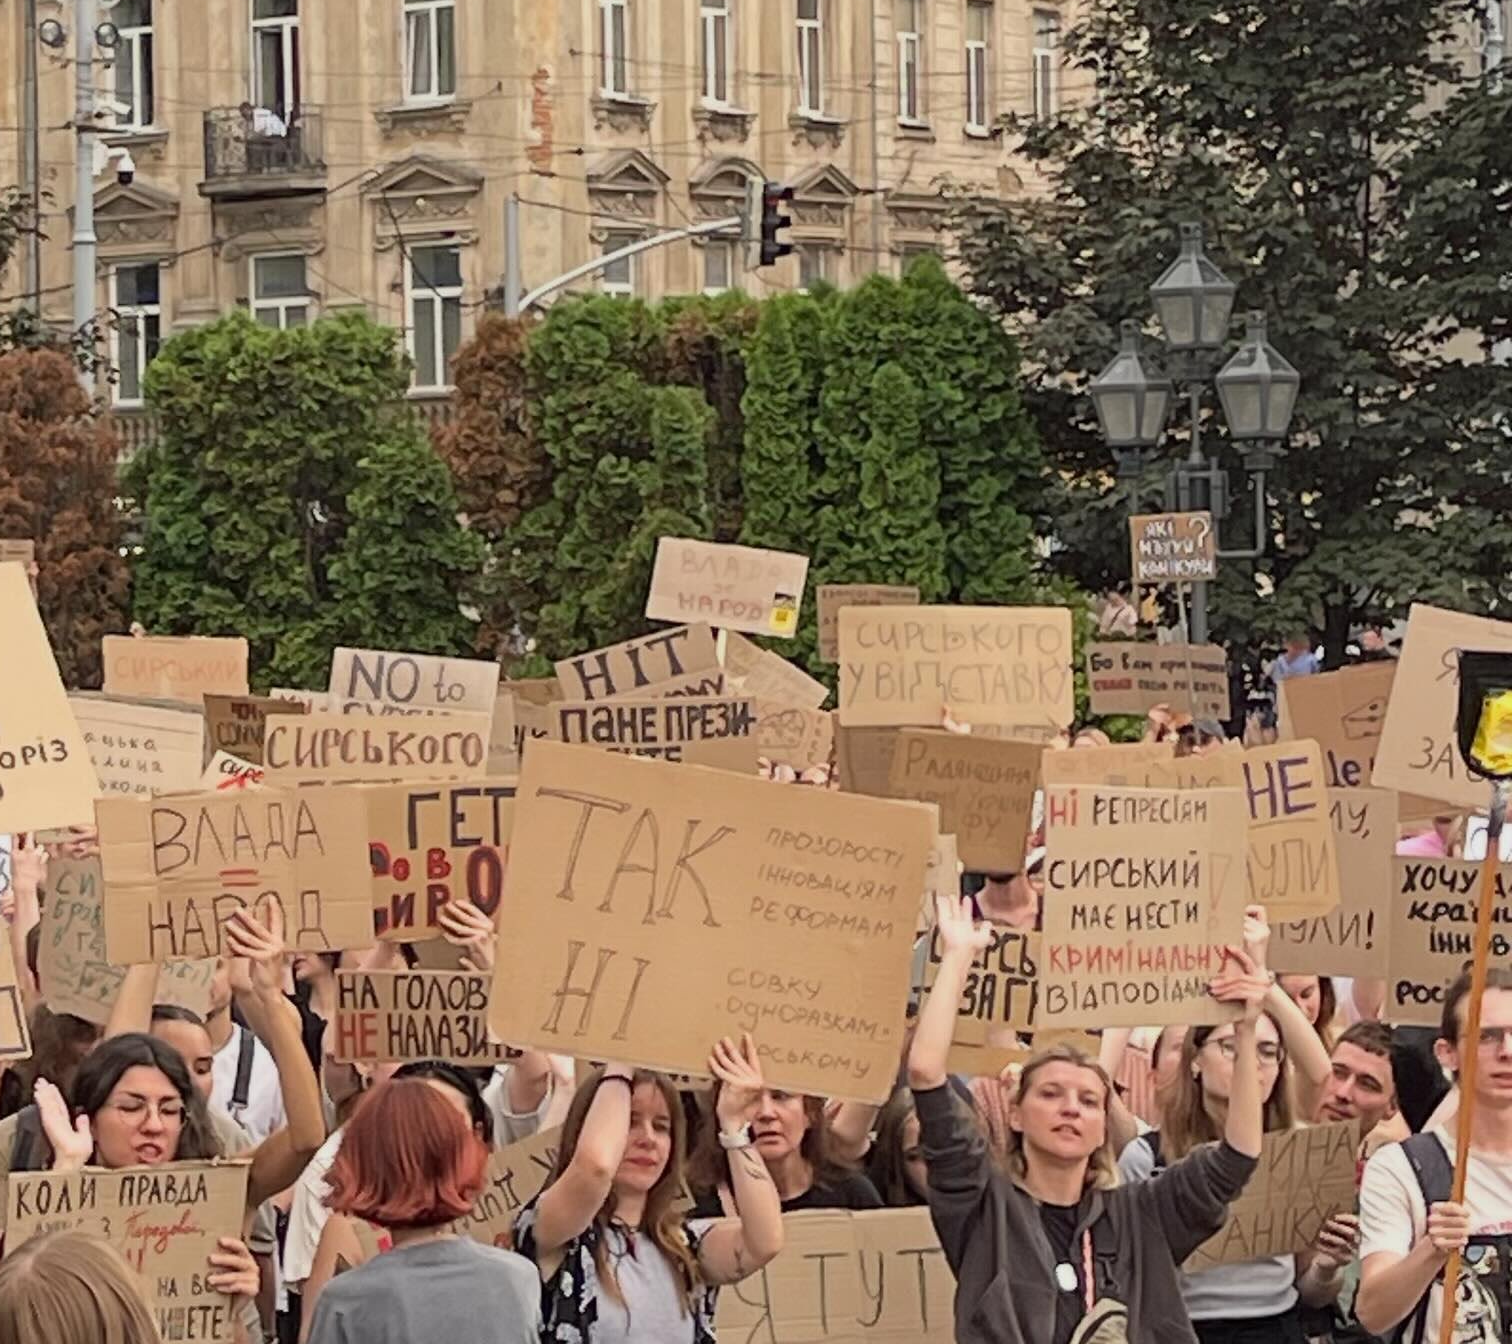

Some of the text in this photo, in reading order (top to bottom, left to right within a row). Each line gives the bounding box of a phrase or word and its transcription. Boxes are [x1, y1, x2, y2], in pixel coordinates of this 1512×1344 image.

[855, 620, 1064, 655] СИРСЬКОГО
[348, 653, 421, 703] NO
[433, 663, 466, 703] to
[875, 659, 1073, 707] ВІДСТАВКУ
[266, 725, 484, 770] СИРСЬКОГО
[1049, 787, 1079, 827] НІ
[1091, 792, 1208, 827] РЕПРЕСІЯМ
[1242, 756, 1317, 820] НЕ
[151, 799, 326, 877] ВЛАДА
[407, 786, 517, 851] ГЕТ
[535, 785, 737, 928] ТАК
[764, 826, 905, 869] ПРОЗОРОСТІ
[1048, 849, 1200, 890] СИРСЬКИЙ
[1401, 863, 1479, 894] ХОЧУ
[757, 863, 897, 903] ІННОВАЦІЯМ
[749, 894, 894, 935] РЕФОРМАМ
[1071, 899, 1199, 932] МАЄ НЕСТИ
[1048, 938, 1232, 975] КРИМІНАЛЬНУ
[338, 973, 489, 1011] НА ГОЛОВ
[541, 939, 823, 1042] НІ СОВКУ
[338, 1014, 379, 1057] НЕ
[15, 1172, 209, 1220] КОЛИ ПРАВДА
[802, 1247, 944, 1334] ТУТ
